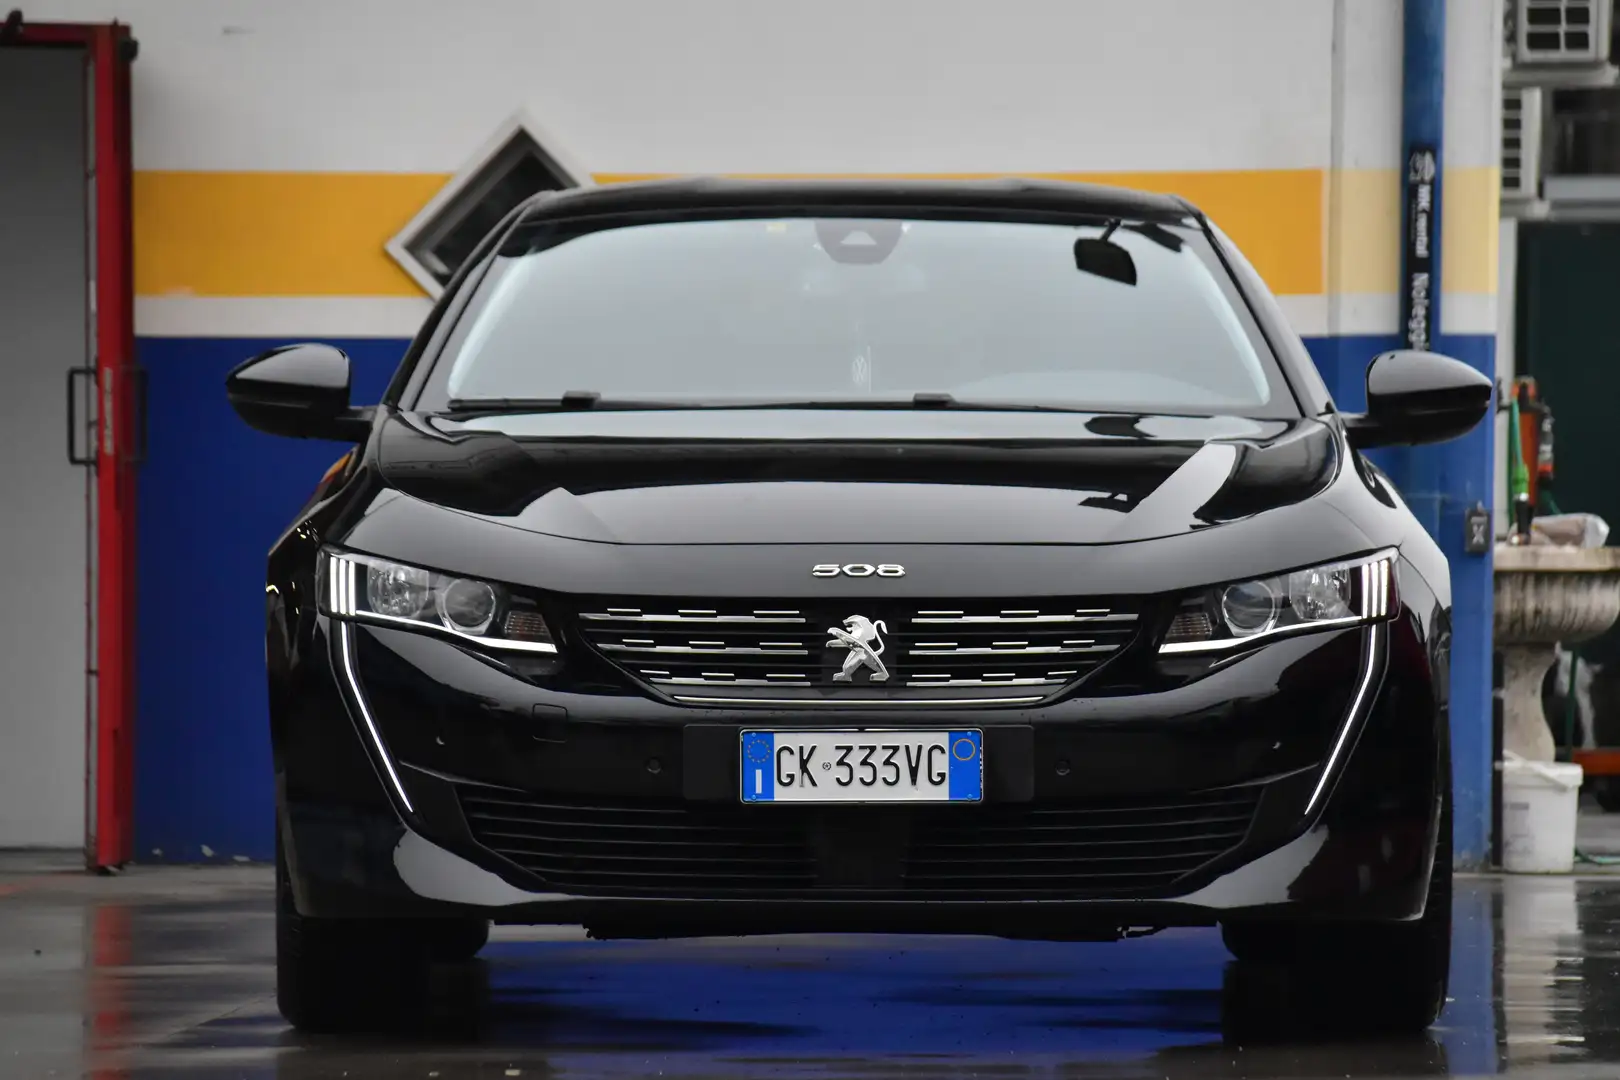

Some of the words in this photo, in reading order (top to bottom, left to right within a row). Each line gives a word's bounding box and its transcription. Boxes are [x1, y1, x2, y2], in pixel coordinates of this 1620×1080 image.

[1408, 272, 1430, 351] Noleggi
[812, 563, 906, 577] 508
[755, 769, 762, 794] I
[776, 744, 818, 788] GK
[835, 744, 946, 788] 333VG
